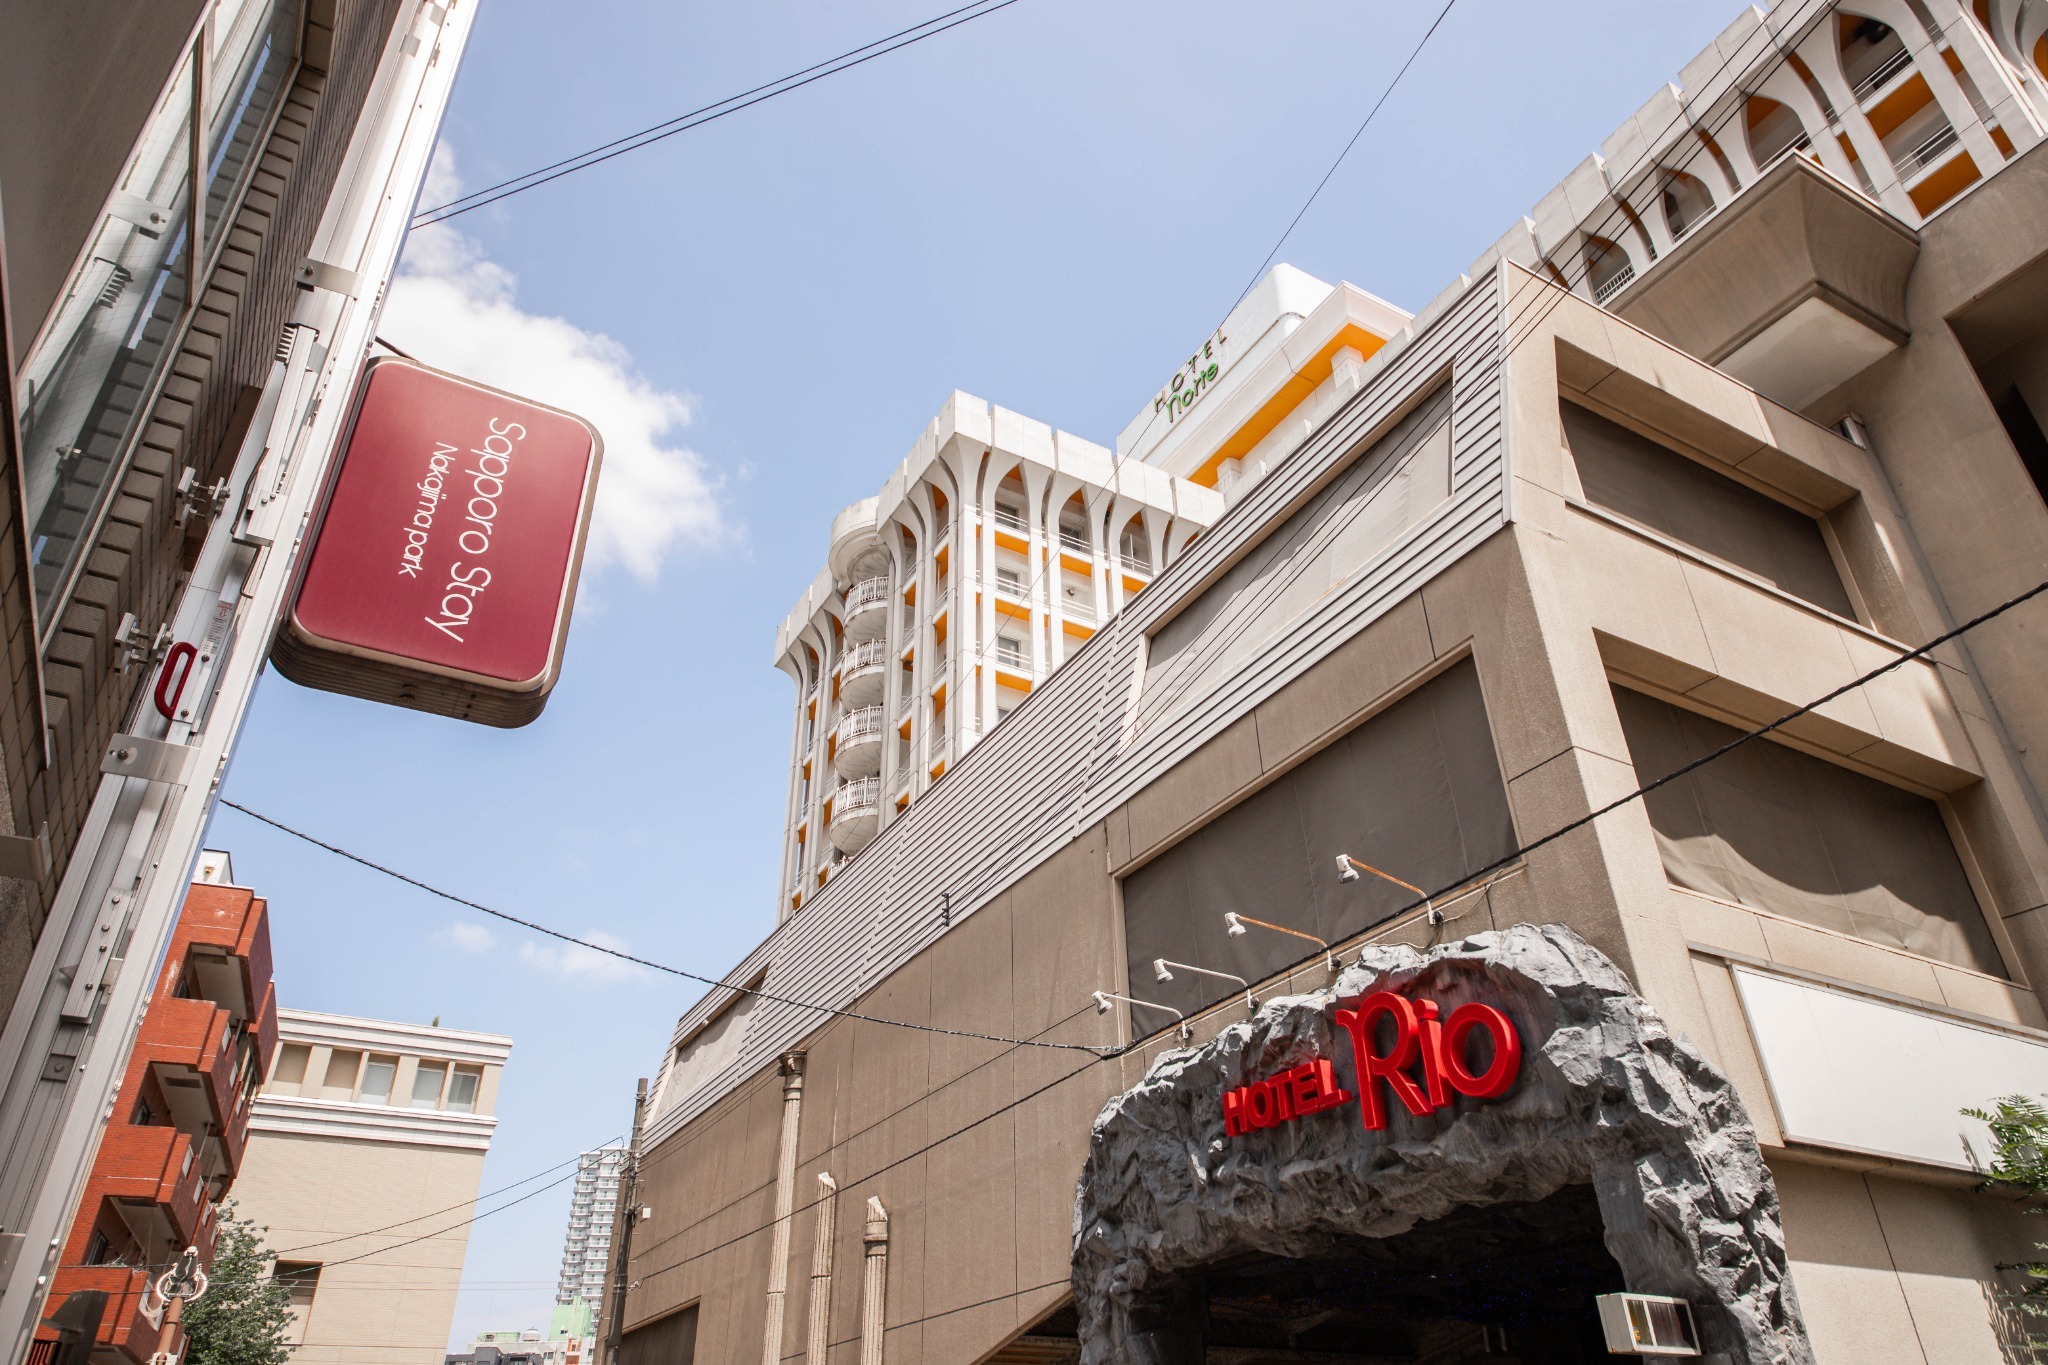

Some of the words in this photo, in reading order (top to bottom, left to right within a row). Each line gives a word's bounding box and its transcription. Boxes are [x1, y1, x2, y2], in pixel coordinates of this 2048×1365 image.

[1153, 328, 1228, 413] HOTEL
[413, 441, 459, 528] Nakajima
[459, 416, 527, 555] Sapporo
[398, 526, 429, 579] park
[424, 561, 492, 643] Stay
[1222, 1058, 1353, 1138] HOTEL
[1335, 991, 1521, 1132] Rio
